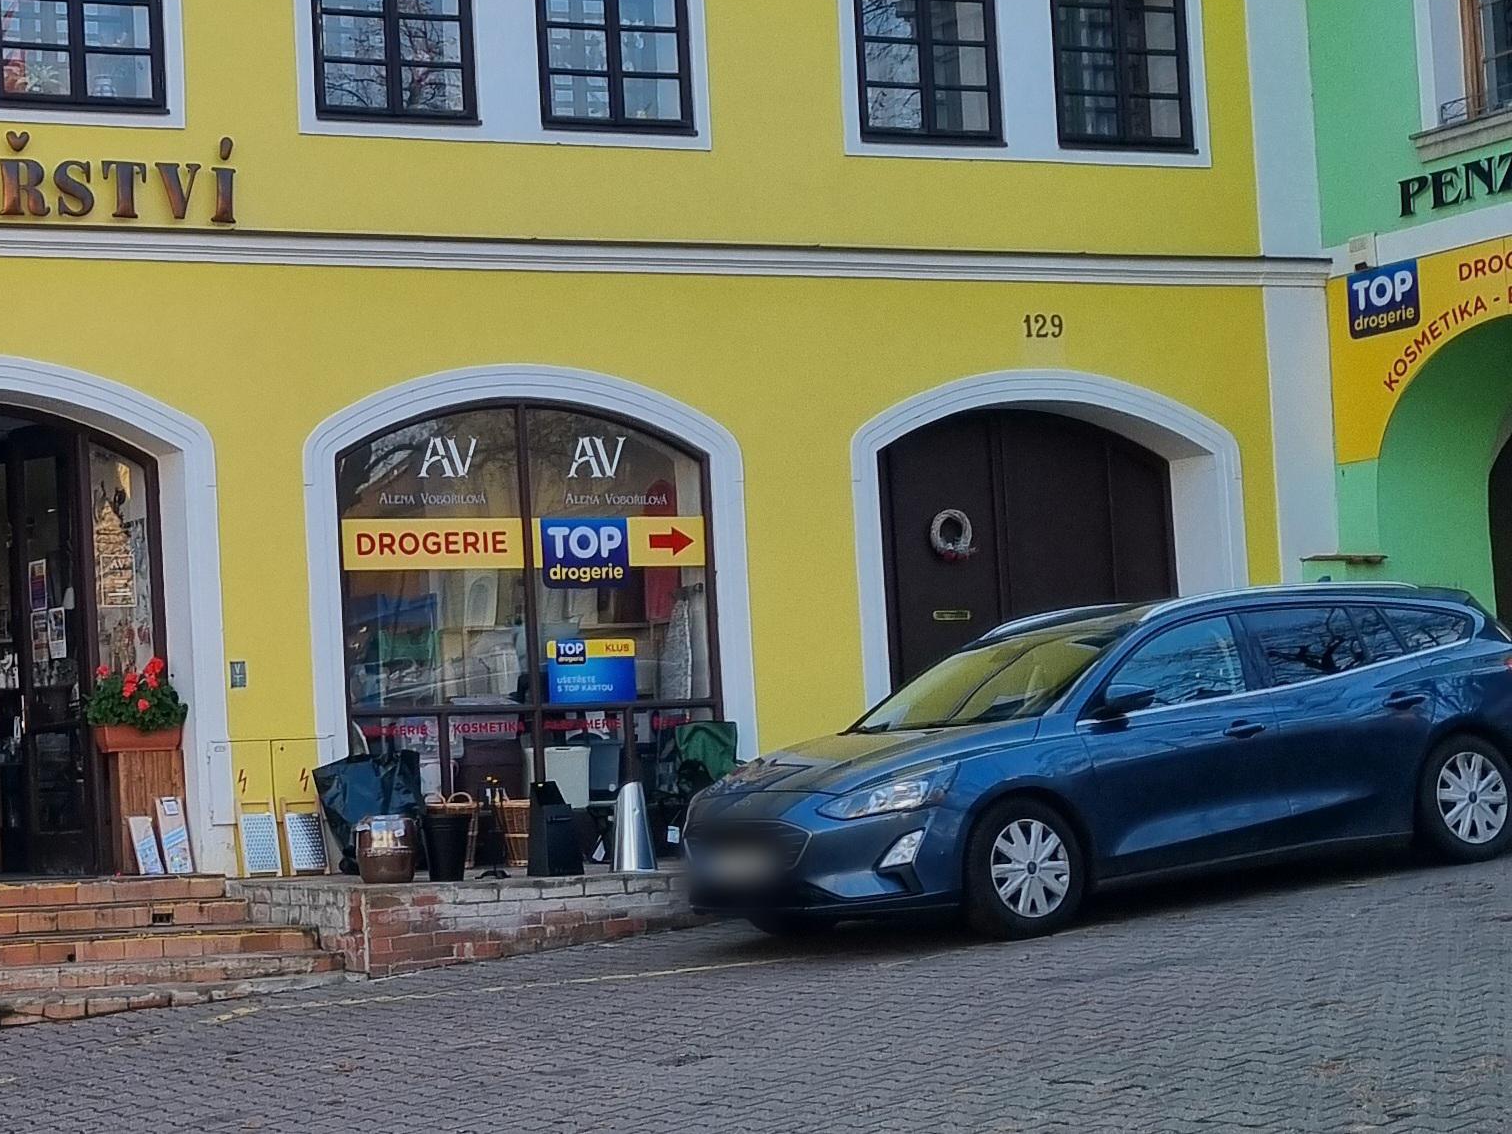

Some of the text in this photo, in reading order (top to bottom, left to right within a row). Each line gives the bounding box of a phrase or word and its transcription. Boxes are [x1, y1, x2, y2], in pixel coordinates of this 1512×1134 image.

[1352, 270, 1413, 311] TOP
[1023, 314, 1063, 338] 129
[1354, 304, 1415, 332] drogerie
[1383, 295, 1487, 392] KOSMETIKA
[417, 435, 479, 478] AV
[567, 436, 626, 478] AV
[356, 531, 508, 556] DROGERIE
[547, 526, 622, 559] TOP
[549, 563, 624, 582] drogerie
[557, 642, 584, 655] TOP
[454, 721, 526, 734] KOSMETIKA
